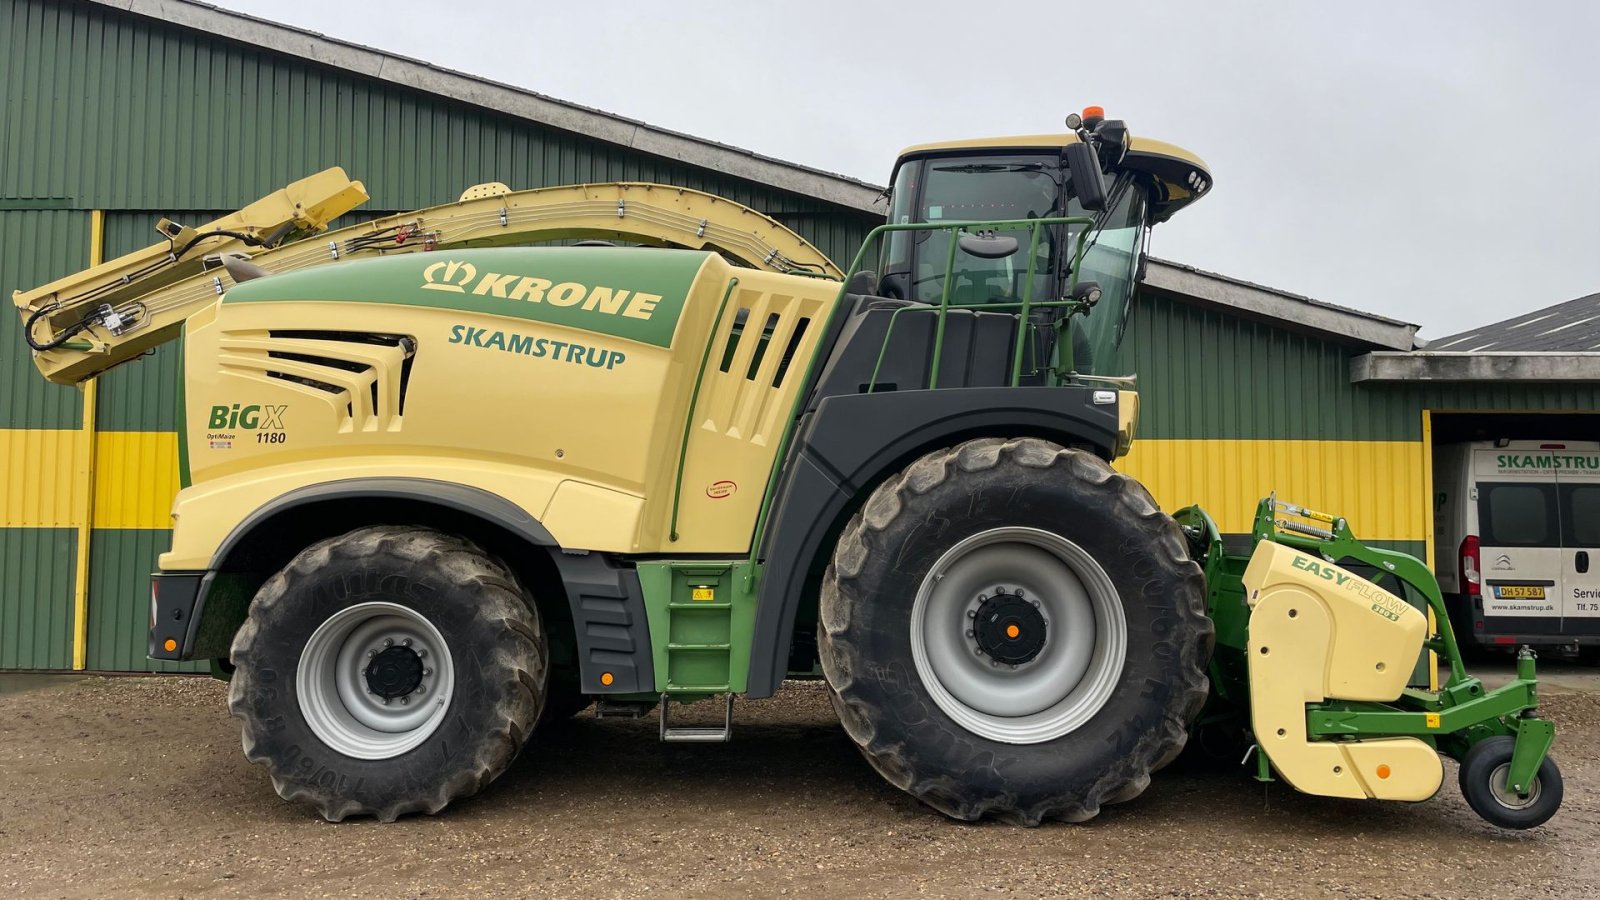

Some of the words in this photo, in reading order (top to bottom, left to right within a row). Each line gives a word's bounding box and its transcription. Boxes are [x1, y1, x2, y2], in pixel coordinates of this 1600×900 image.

[472, 272, 663, 321] KRONE
[448, 324, 626, 370] SKAMSTRUP
[256, 432, 286, 444] 1180
[1497, 455, 1599, 469] SKAMSTRU
[1501, 587, 1513, 596] DH
[1515, 587, 1525, 596] 57
[1527, 587, 1542, 596] 587
[1373, 605, 1390, 617] 380
[1492, 604, 1554, 612] www.skamstrup.dk
[1576, 603, 1588, 611] Tlf.
[1590, 603, 1599, 611] 75
